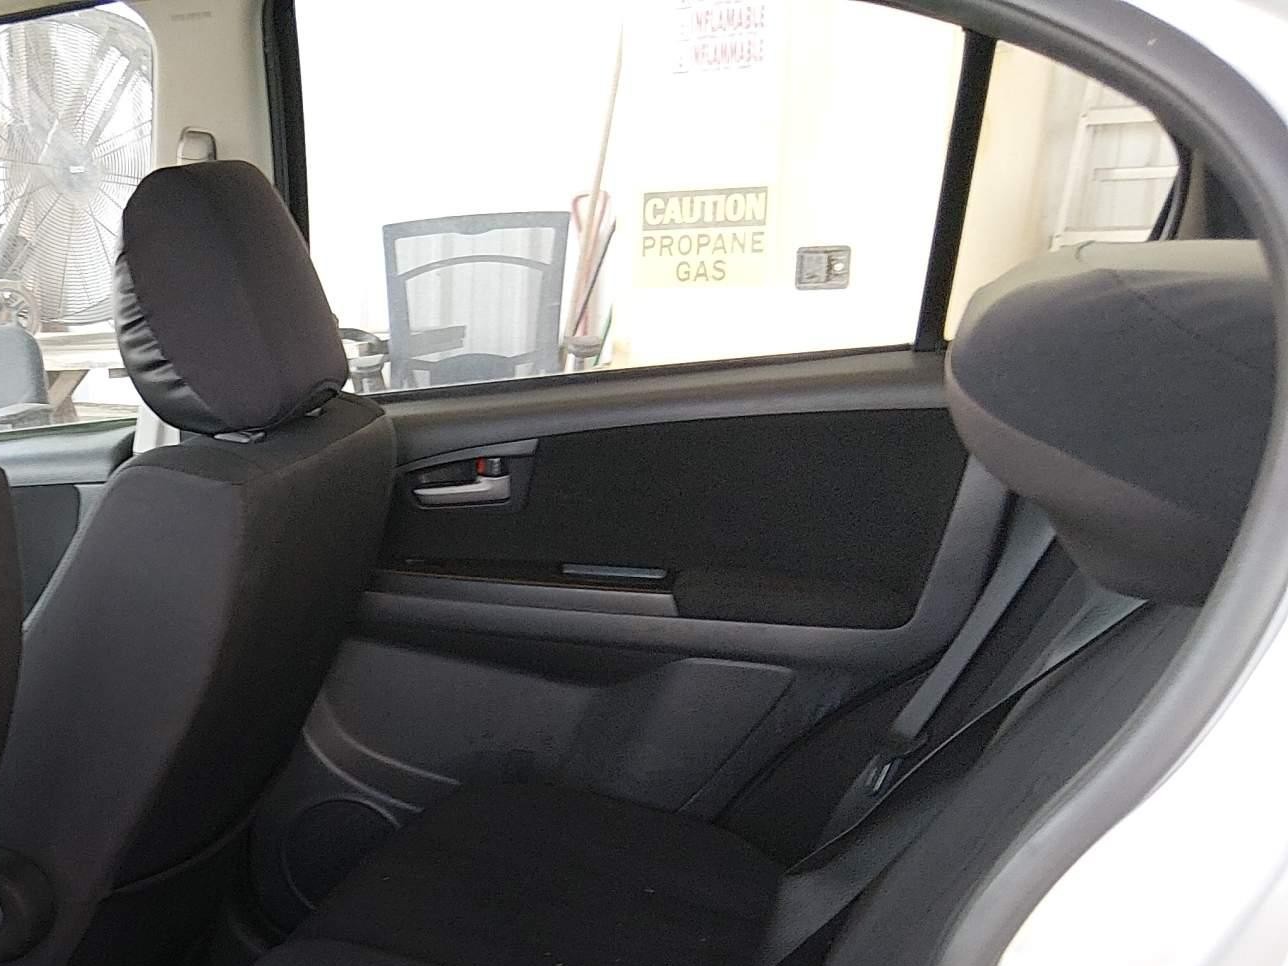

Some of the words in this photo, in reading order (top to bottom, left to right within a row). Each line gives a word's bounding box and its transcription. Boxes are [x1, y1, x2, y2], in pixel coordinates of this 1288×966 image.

[644, 192, 766, 226] CAUTION
[642, 231, 765, 257] PROPANE
[675, 259, 727, 282] GAS
